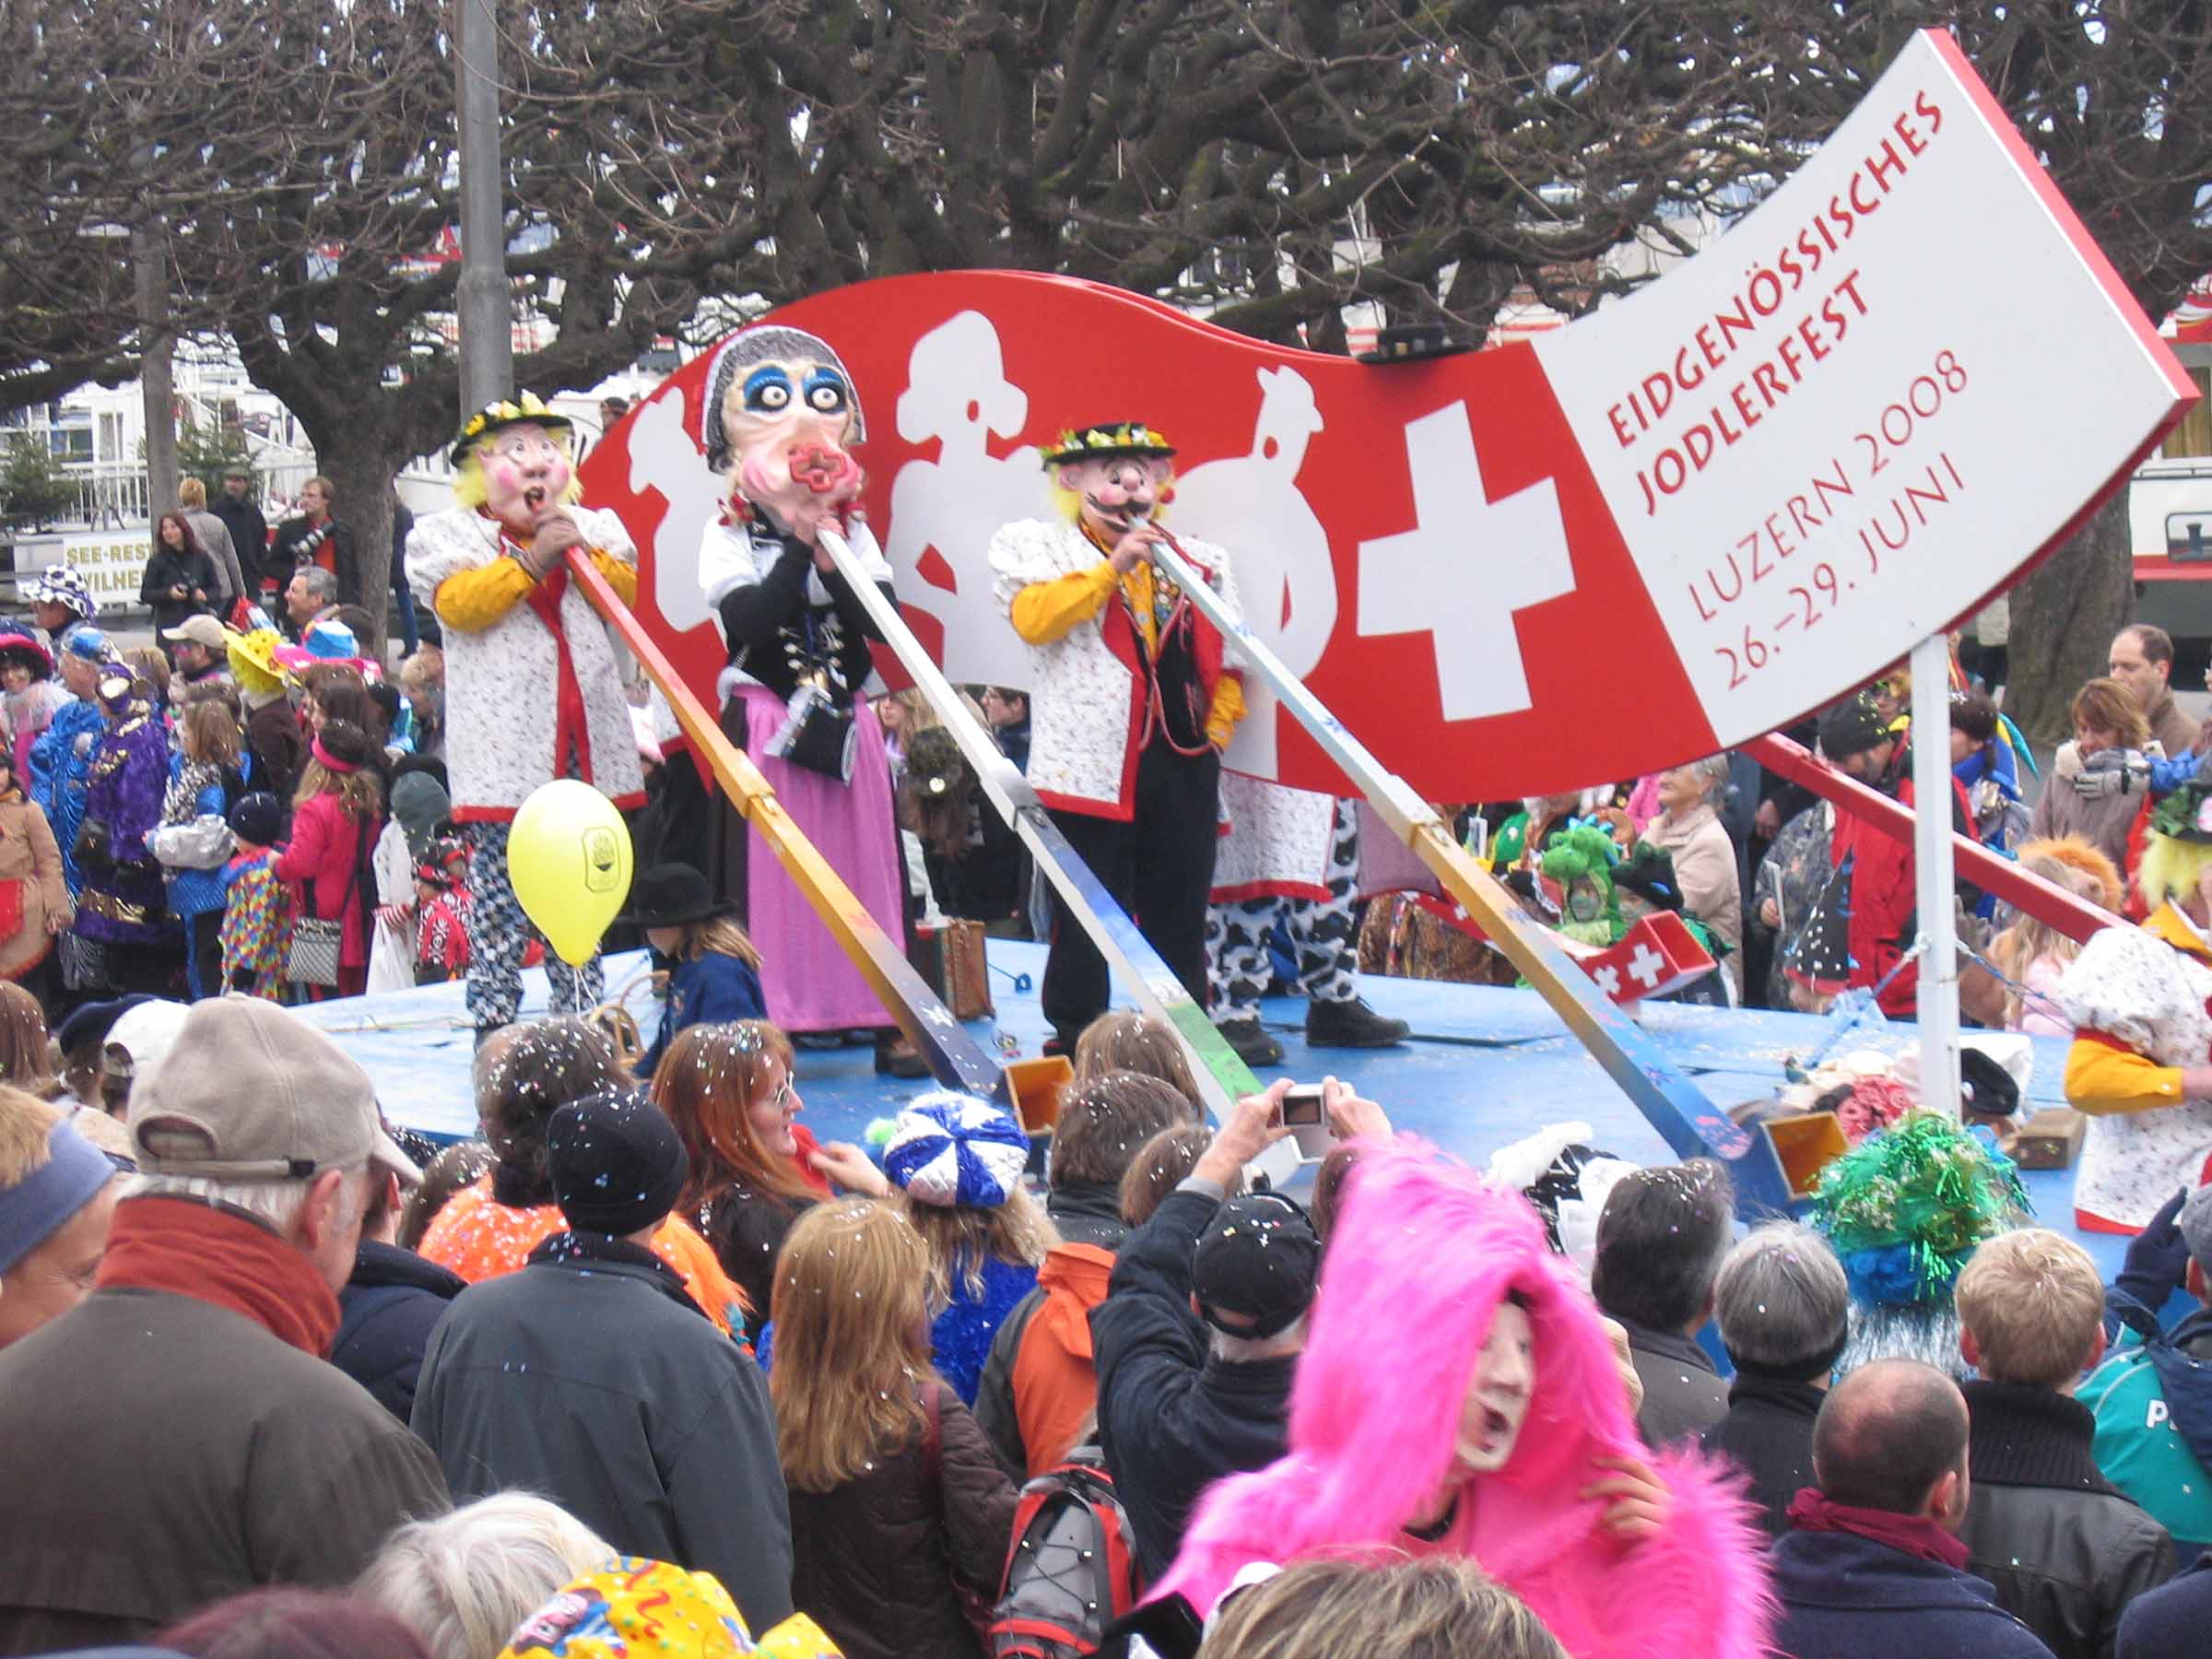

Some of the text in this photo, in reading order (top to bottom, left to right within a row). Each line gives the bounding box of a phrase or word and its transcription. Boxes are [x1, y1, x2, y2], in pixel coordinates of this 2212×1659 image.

[1606, 88, 1944, 449] EIDGENÖSSISCHES
[1636, 267, 1871, 517] JODLERFEST
[1688, 347, 1970, 625] LUZERN 2008
[1855, 452, 1966, 576] JUNI
